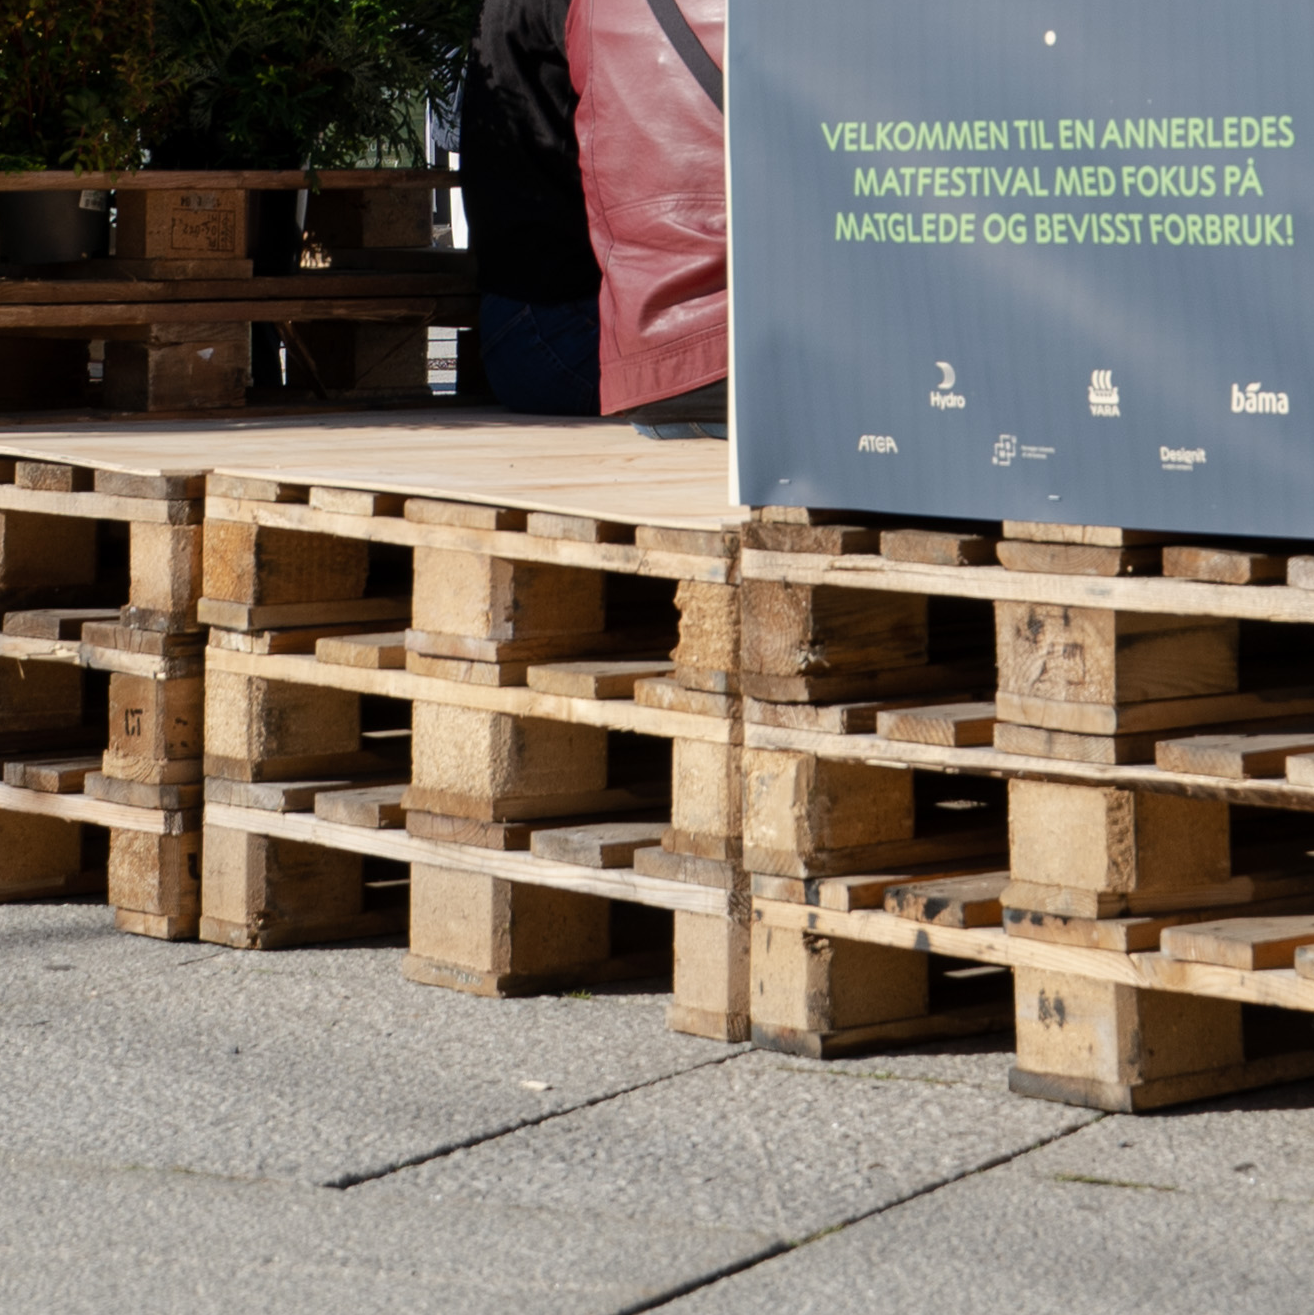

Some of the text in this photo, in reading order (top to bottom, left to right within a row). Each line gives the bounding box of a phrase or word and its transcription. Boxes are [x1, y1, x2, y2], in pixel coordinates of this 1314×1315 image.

[821, 116, 1295, 151] VELKOMMEN TIL EN ANNERLEDES
[853, 158, 1263, 197] MATFESTIVAL MED FOKUS PÅ
[835, 212, 1294, 246] MATGLEDE OG BEVISST FORBRUK!
[930, 391, 965, 410] Hydro
[1090, 405, 1120, 417] YARA
[858, 435, 898, 454] ATEA
[1159, 446, 1206, 464] Designit
